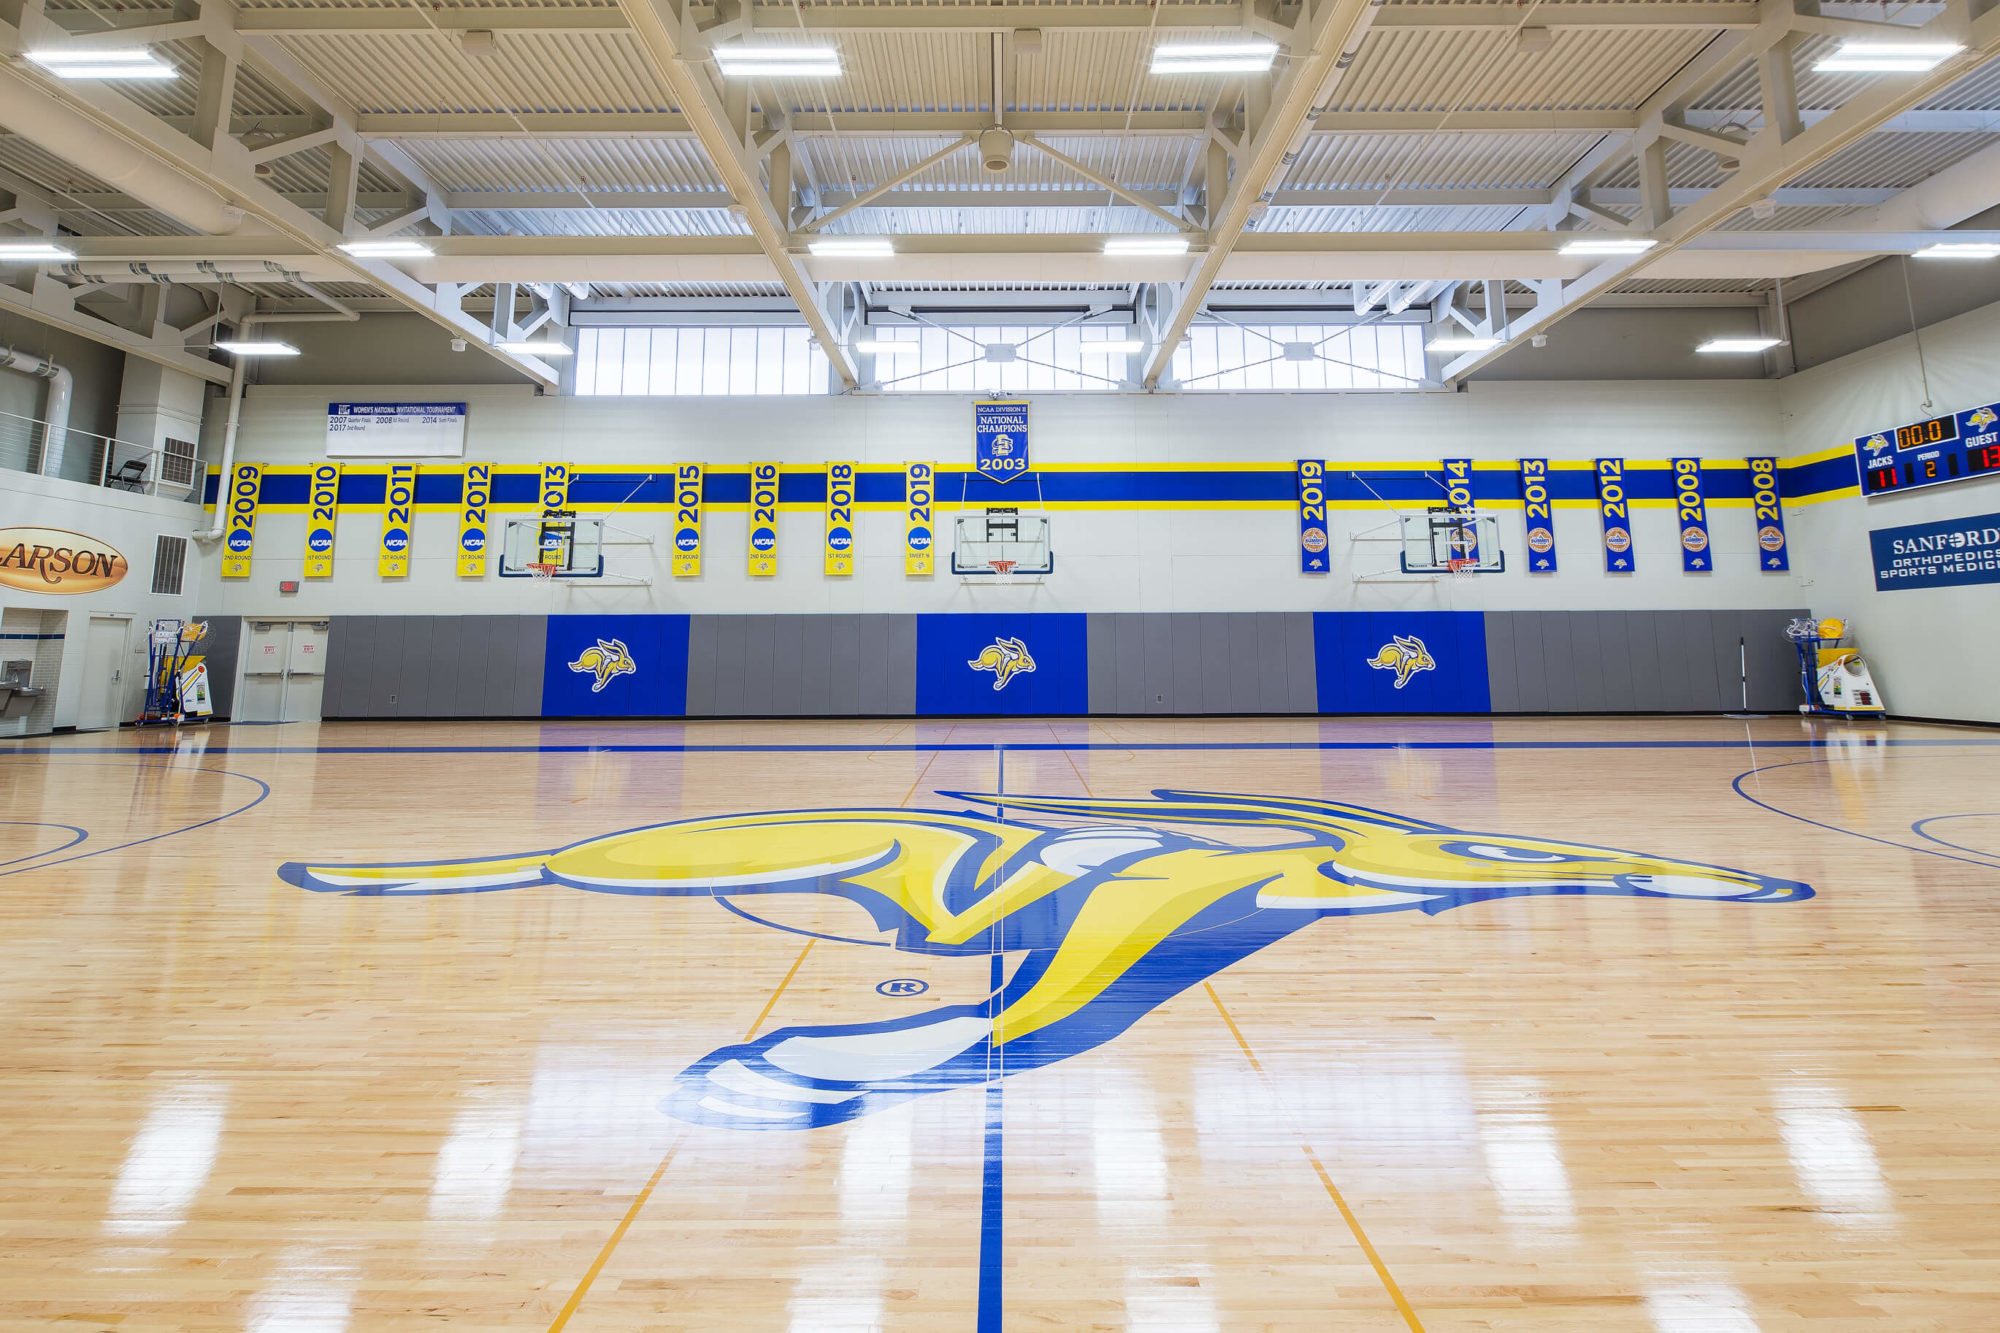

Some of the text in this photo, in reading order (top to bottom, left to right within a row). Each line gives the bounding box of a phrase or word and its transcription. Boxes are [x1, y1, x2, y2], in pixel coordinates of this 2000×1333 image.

[976, 424, 1028, 433] CHAMPIONS
[980, 416, 1024, 424] NATIONAL
[1965, 432, 1998, 448] GUEST
[980, 458, 1026, 470] 2003
[1867, 456, 1893, 469] JACKS
[1917, 450, 1940, 462] PERIOD
[1926, 461, 1937, 478] 2
[232, 466, 259, 528] 2009
[313, 466, 336, 520] 2010
[388, 466, 412, 524] 2011
[465, 465, 488, 523] 2012
[678, 465, 699, 523] 2015
[754, 465, 776, 522] 2016
[830, 464, 852, 522] 2018
[910, 464, 930, 522] 2019
[1301, 461, 1323, 521] 2019
[1523, 460, 1548, 519] 2013
[1600, 459, 1625, 519] 2012
[1676, 459, 1702, 521] 2009
[1752, 459, 1778, 521] 2008
[0, 543, 118, 584] ARSON
[229, 539, 251, 547] NCAA
[310, 539, 332, 547] NCAA
[385, 539, 407, 547] NCAA
[1880, 566, 1937, 579] SPORTS
